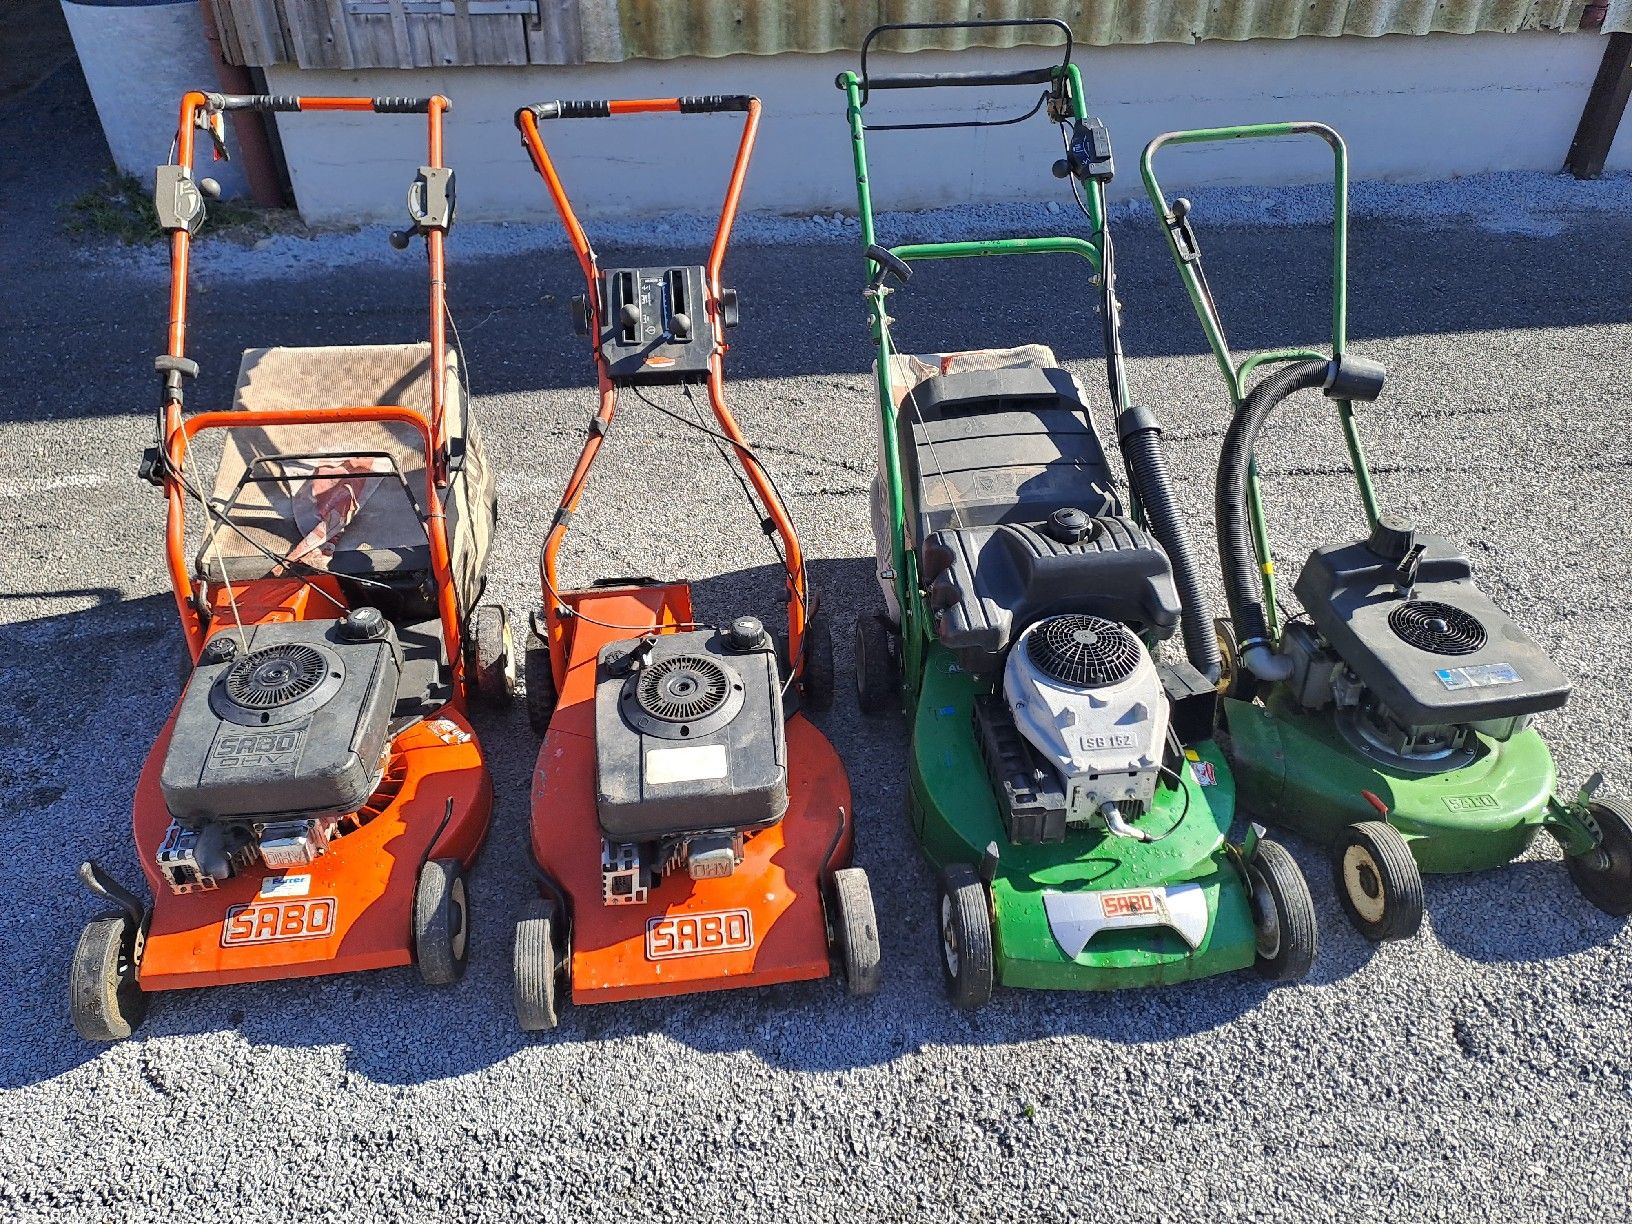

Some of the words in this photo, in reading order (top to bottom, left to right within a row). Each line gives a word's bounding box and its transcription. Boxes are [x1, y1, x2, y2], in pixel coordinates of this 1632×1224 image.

[217, 734, 296, 756] SABO
[1086, 736, 1105, 749] SB
[1109, 735, 1132, 747] 152
[219, 755, 284, 767] OHV
[267, 849, 303, 865] OHV
[693, 862, 730, 877] OHV
[1103, 894, 1154, 915] SABO
[229, 902, 330, 940] SABO
[653, 914, 748, 953] SABO
